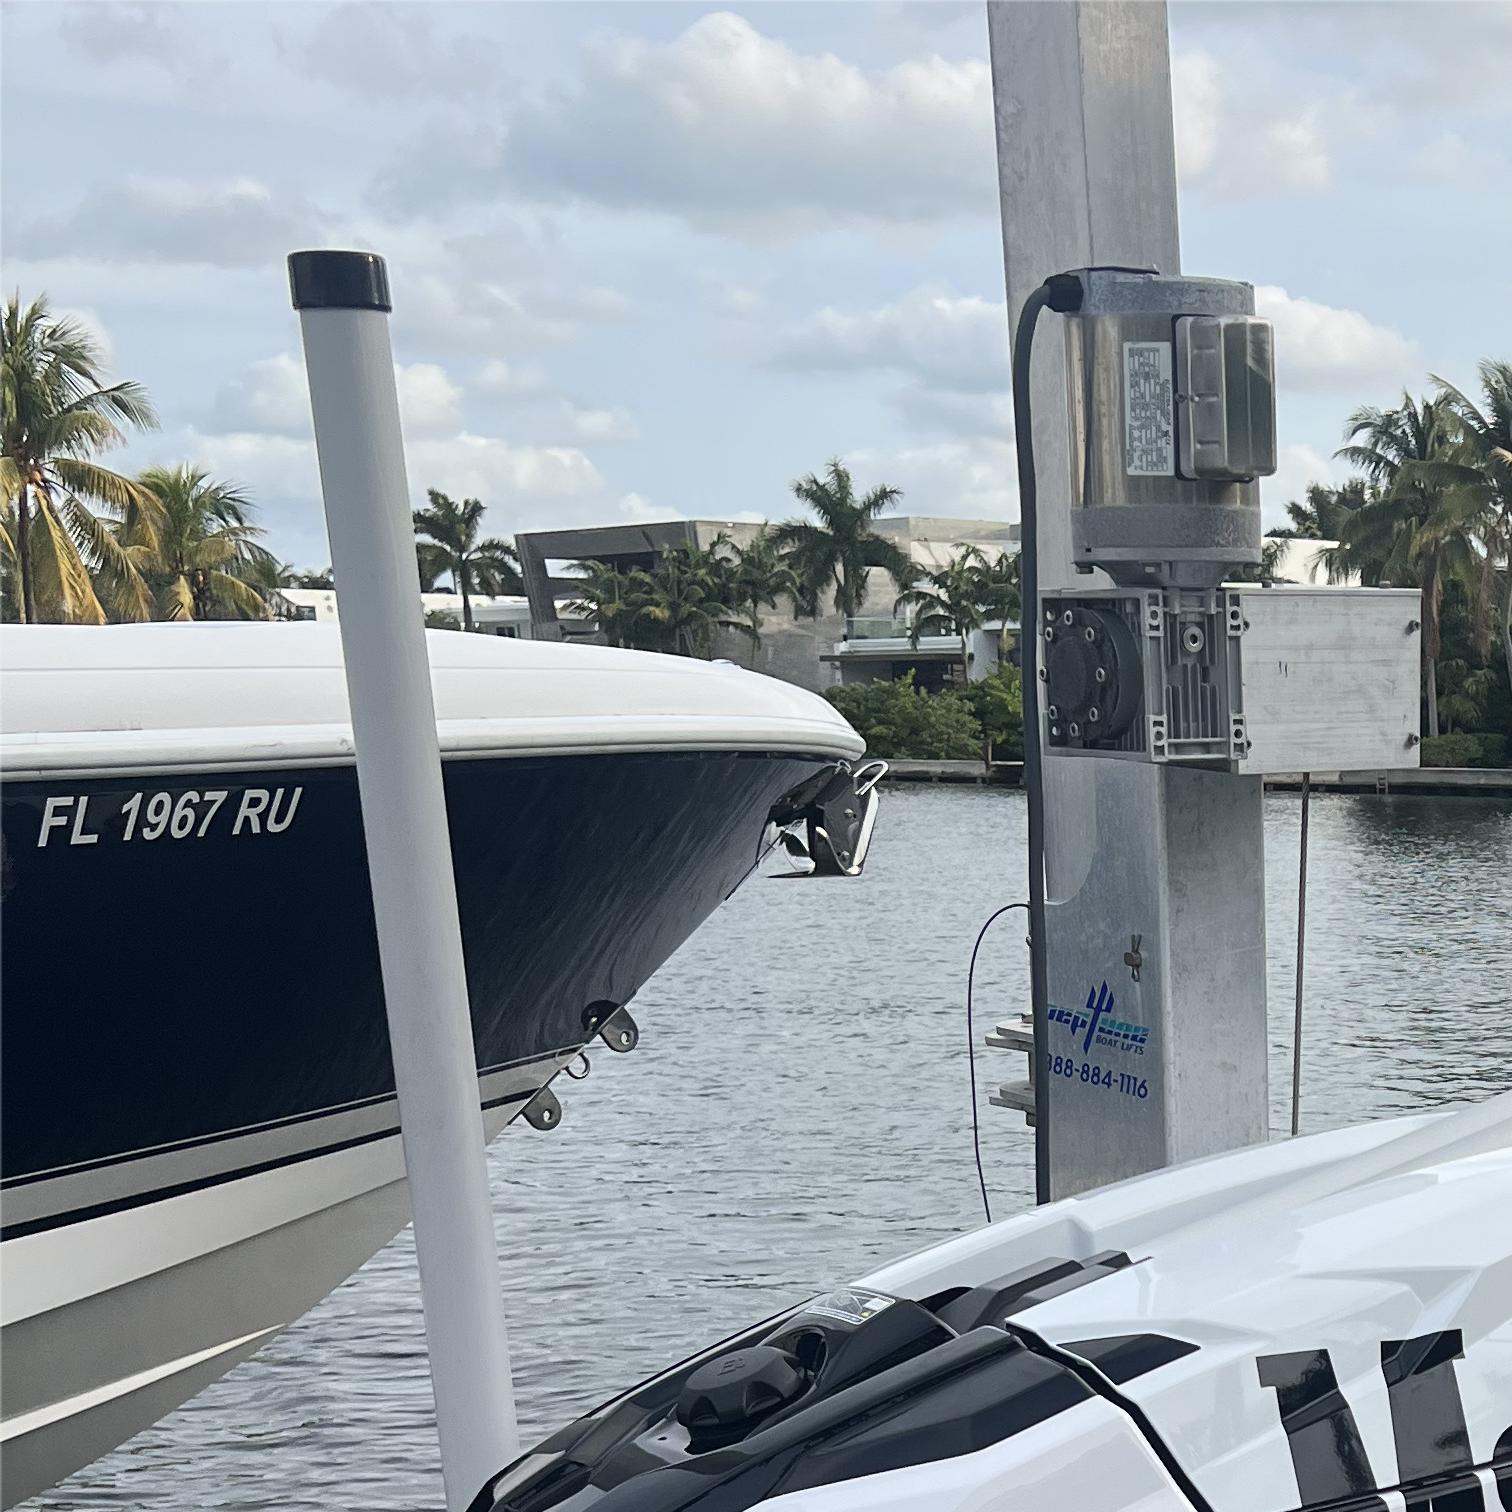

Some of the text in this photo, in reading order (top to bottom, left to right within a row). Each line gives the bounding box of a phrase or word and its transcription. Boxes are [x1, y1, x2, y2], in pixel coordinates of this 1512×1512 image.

[37, 787, 303, 848] FL 1967 RU
[1096, 1035, 1145, 1056] BOAT LIFTS
